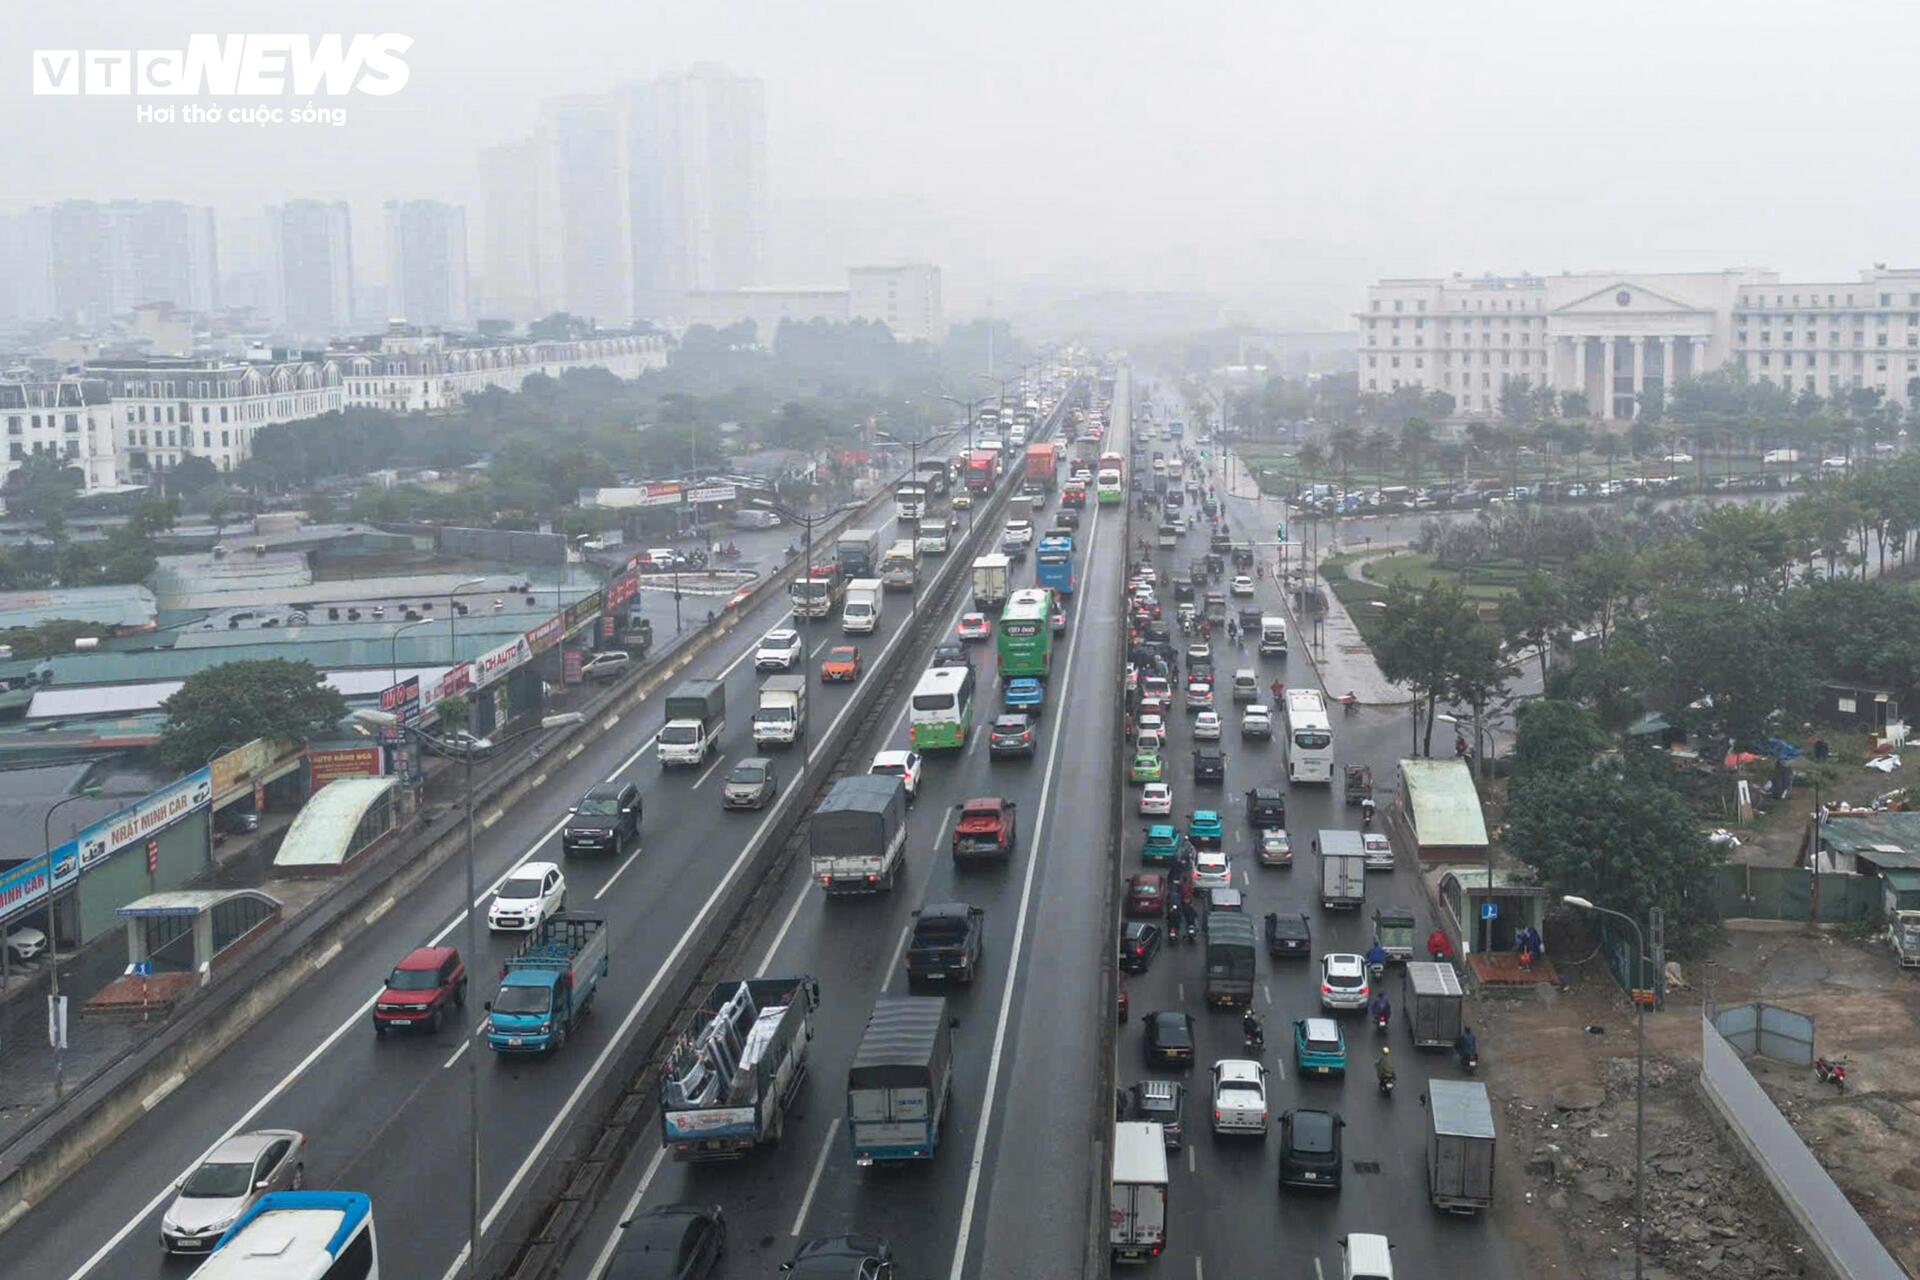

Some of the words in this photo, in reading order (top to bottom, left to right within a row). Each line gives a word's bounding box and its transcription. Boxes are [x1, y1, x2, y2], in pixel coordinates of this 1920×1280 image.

[141, 805, 168, 830] MINH
[169, 794, 188, 815] CAR
[24, 873, 45, 895] CAR
